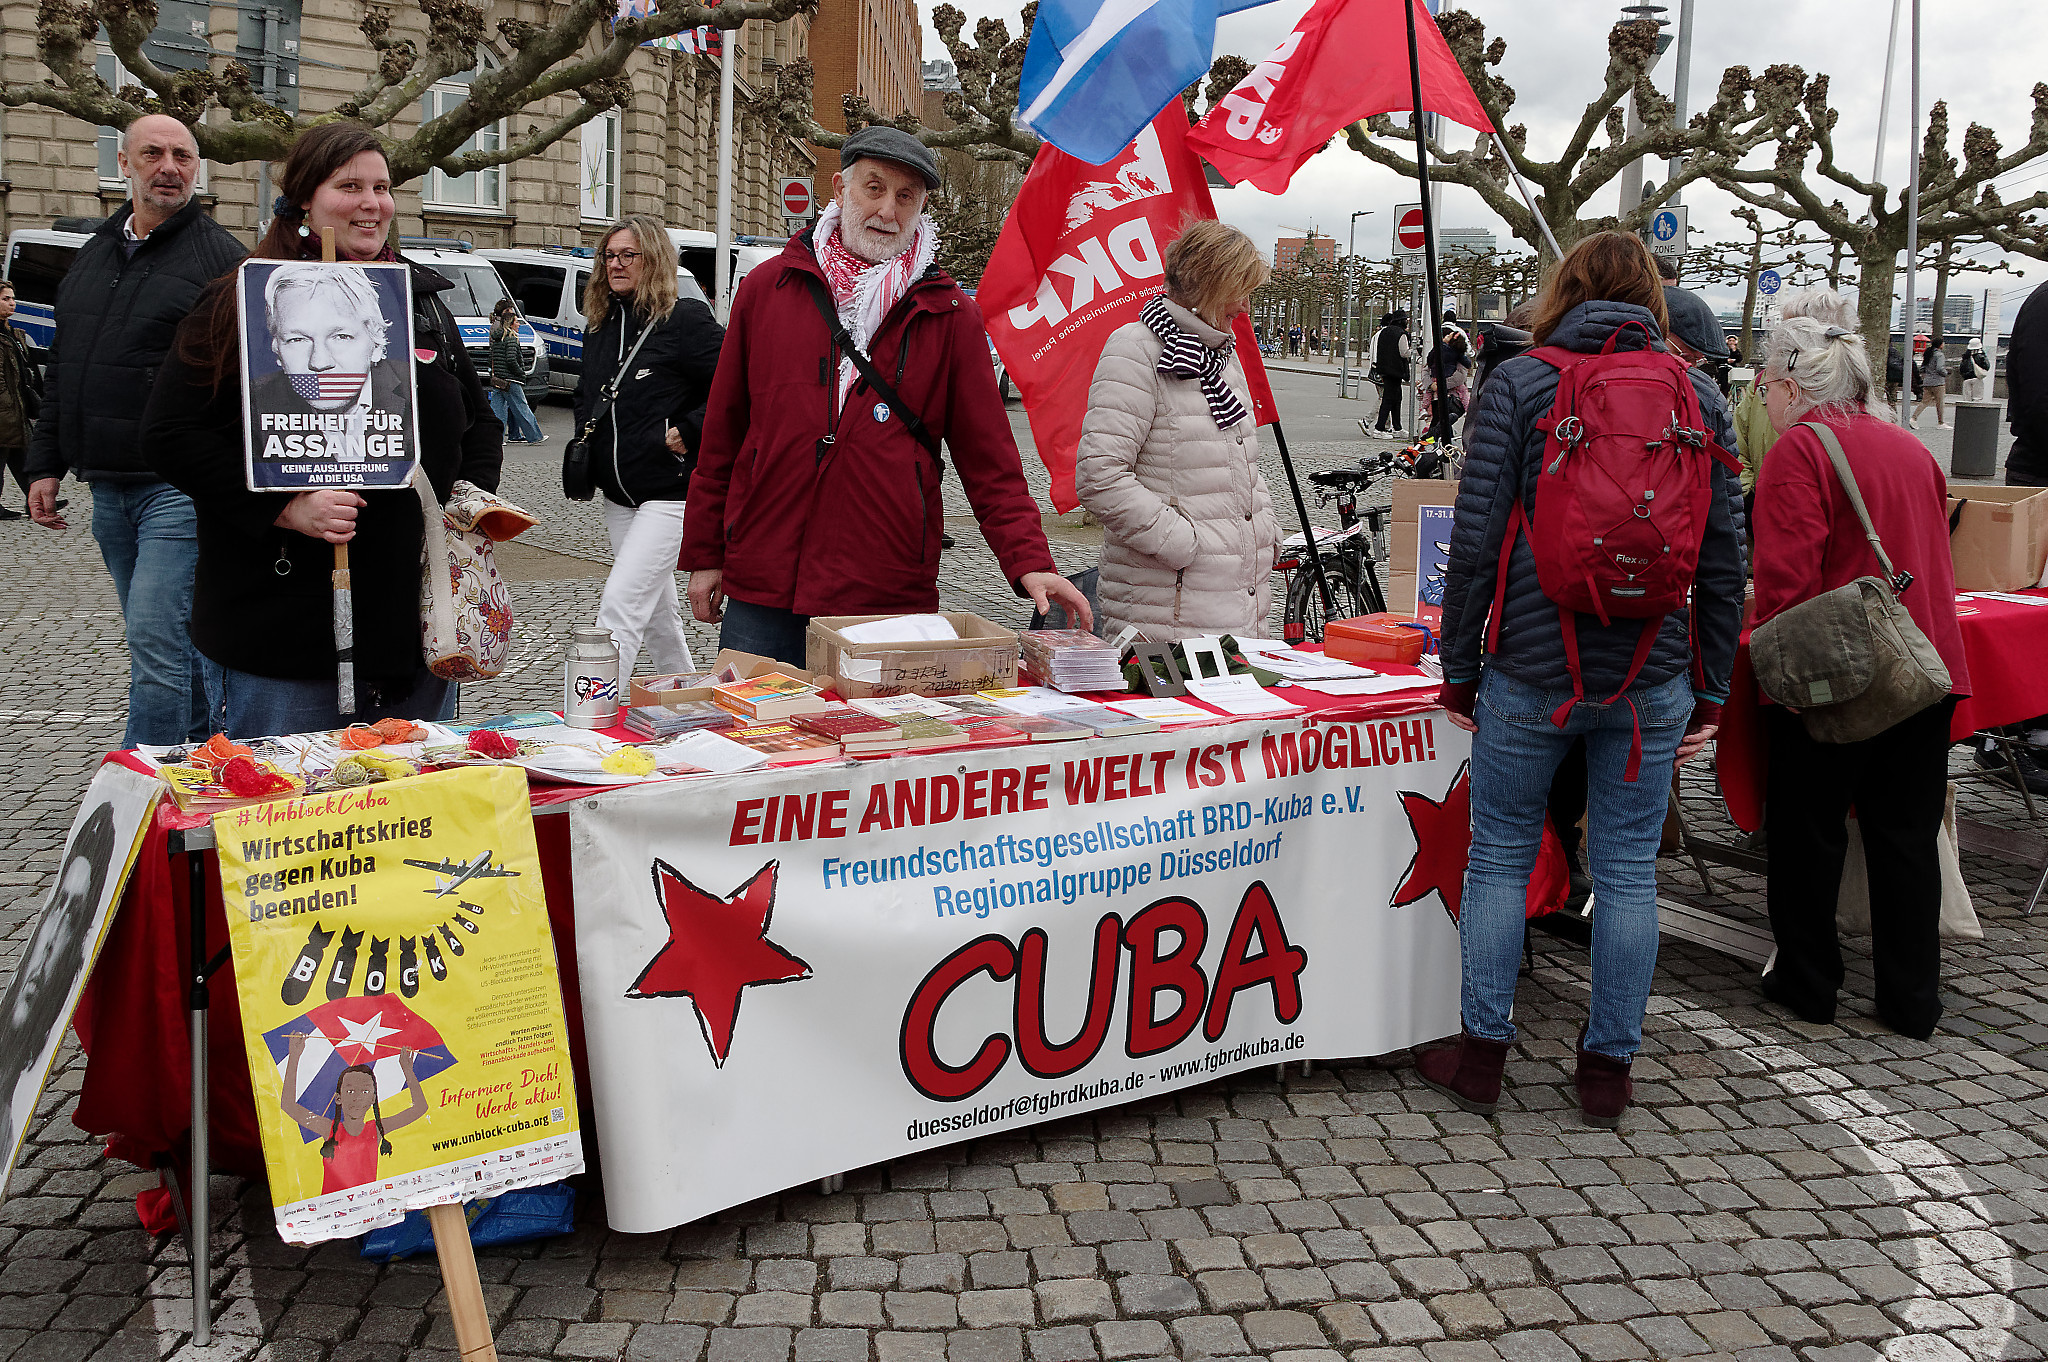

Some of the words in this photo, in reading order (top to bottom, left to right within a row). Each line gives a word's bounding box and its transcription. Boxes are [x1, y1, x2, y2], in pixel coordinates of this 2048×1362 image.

[1654, 245, 1675, 254] ZONE
[261, 413, 360, 431] FREIHEIT
[364, 410, 403, 431] FÜR
[263, 434, 405, 458] ASSANGE
[281, 464, 312, 473] KEINE
[313, 463, 389, 473] AUSLIEFERUNG
[308, 474, 324, 483] AN
[325, 474, 342, 483] DIE
[342, 474, 364, 483] USA
[1425, 509, 1448, 519] 17.-31.
[1616, 553, 1637, 564] Flex
[729, 789, 851, 847] EINE
[858, 763, 1051, 834] ANDERE
[1064, 750, 1176, 806] WELT
[1185, 740, 1249, 790] IST
[1261, 718, 1437, 780] MÖGLICH!
[241, 815, 433, 863] Wirtschaftskrieg
[822, 809, 1196, 891] Freundschaftsgesellschaft
[1202, 793, 1312, 836] BRD-Kuba
[1320, 785, 1366, 816] e.V.
[245, 865, 314, 898] gegen
[320, 854, 376, 882] Kuba
[933, 861, 1151, 920] Regionalgruppe
[1160, 832, 1283, 882] Düsseldorf
[249, 883, 358, 923] beenden!
[899, 879, 1308, 1102] CUBA
[482, 1051, 527, 1066] Finanzblockade
[495, 1038, 517, 1048] endlich
[517, 1034, 533, 1042] Taten
[543, 1037, 555, 1045] und
[439, 1080, 513, 1109] Informiere
[521, 1062, 559, 1086] Dich!
[475, 1100, 518, 1121] Werde
[524, 1083, 562, 1107] aktiv!
[906, 1070, 1145, 1142] duesseldorf@fgbrdkuba.de
[1160, 1033, 1305, 1083] www.fgbrdkuba.de
[432, 1113, 550, 1152] www.unblock-cuba.org
